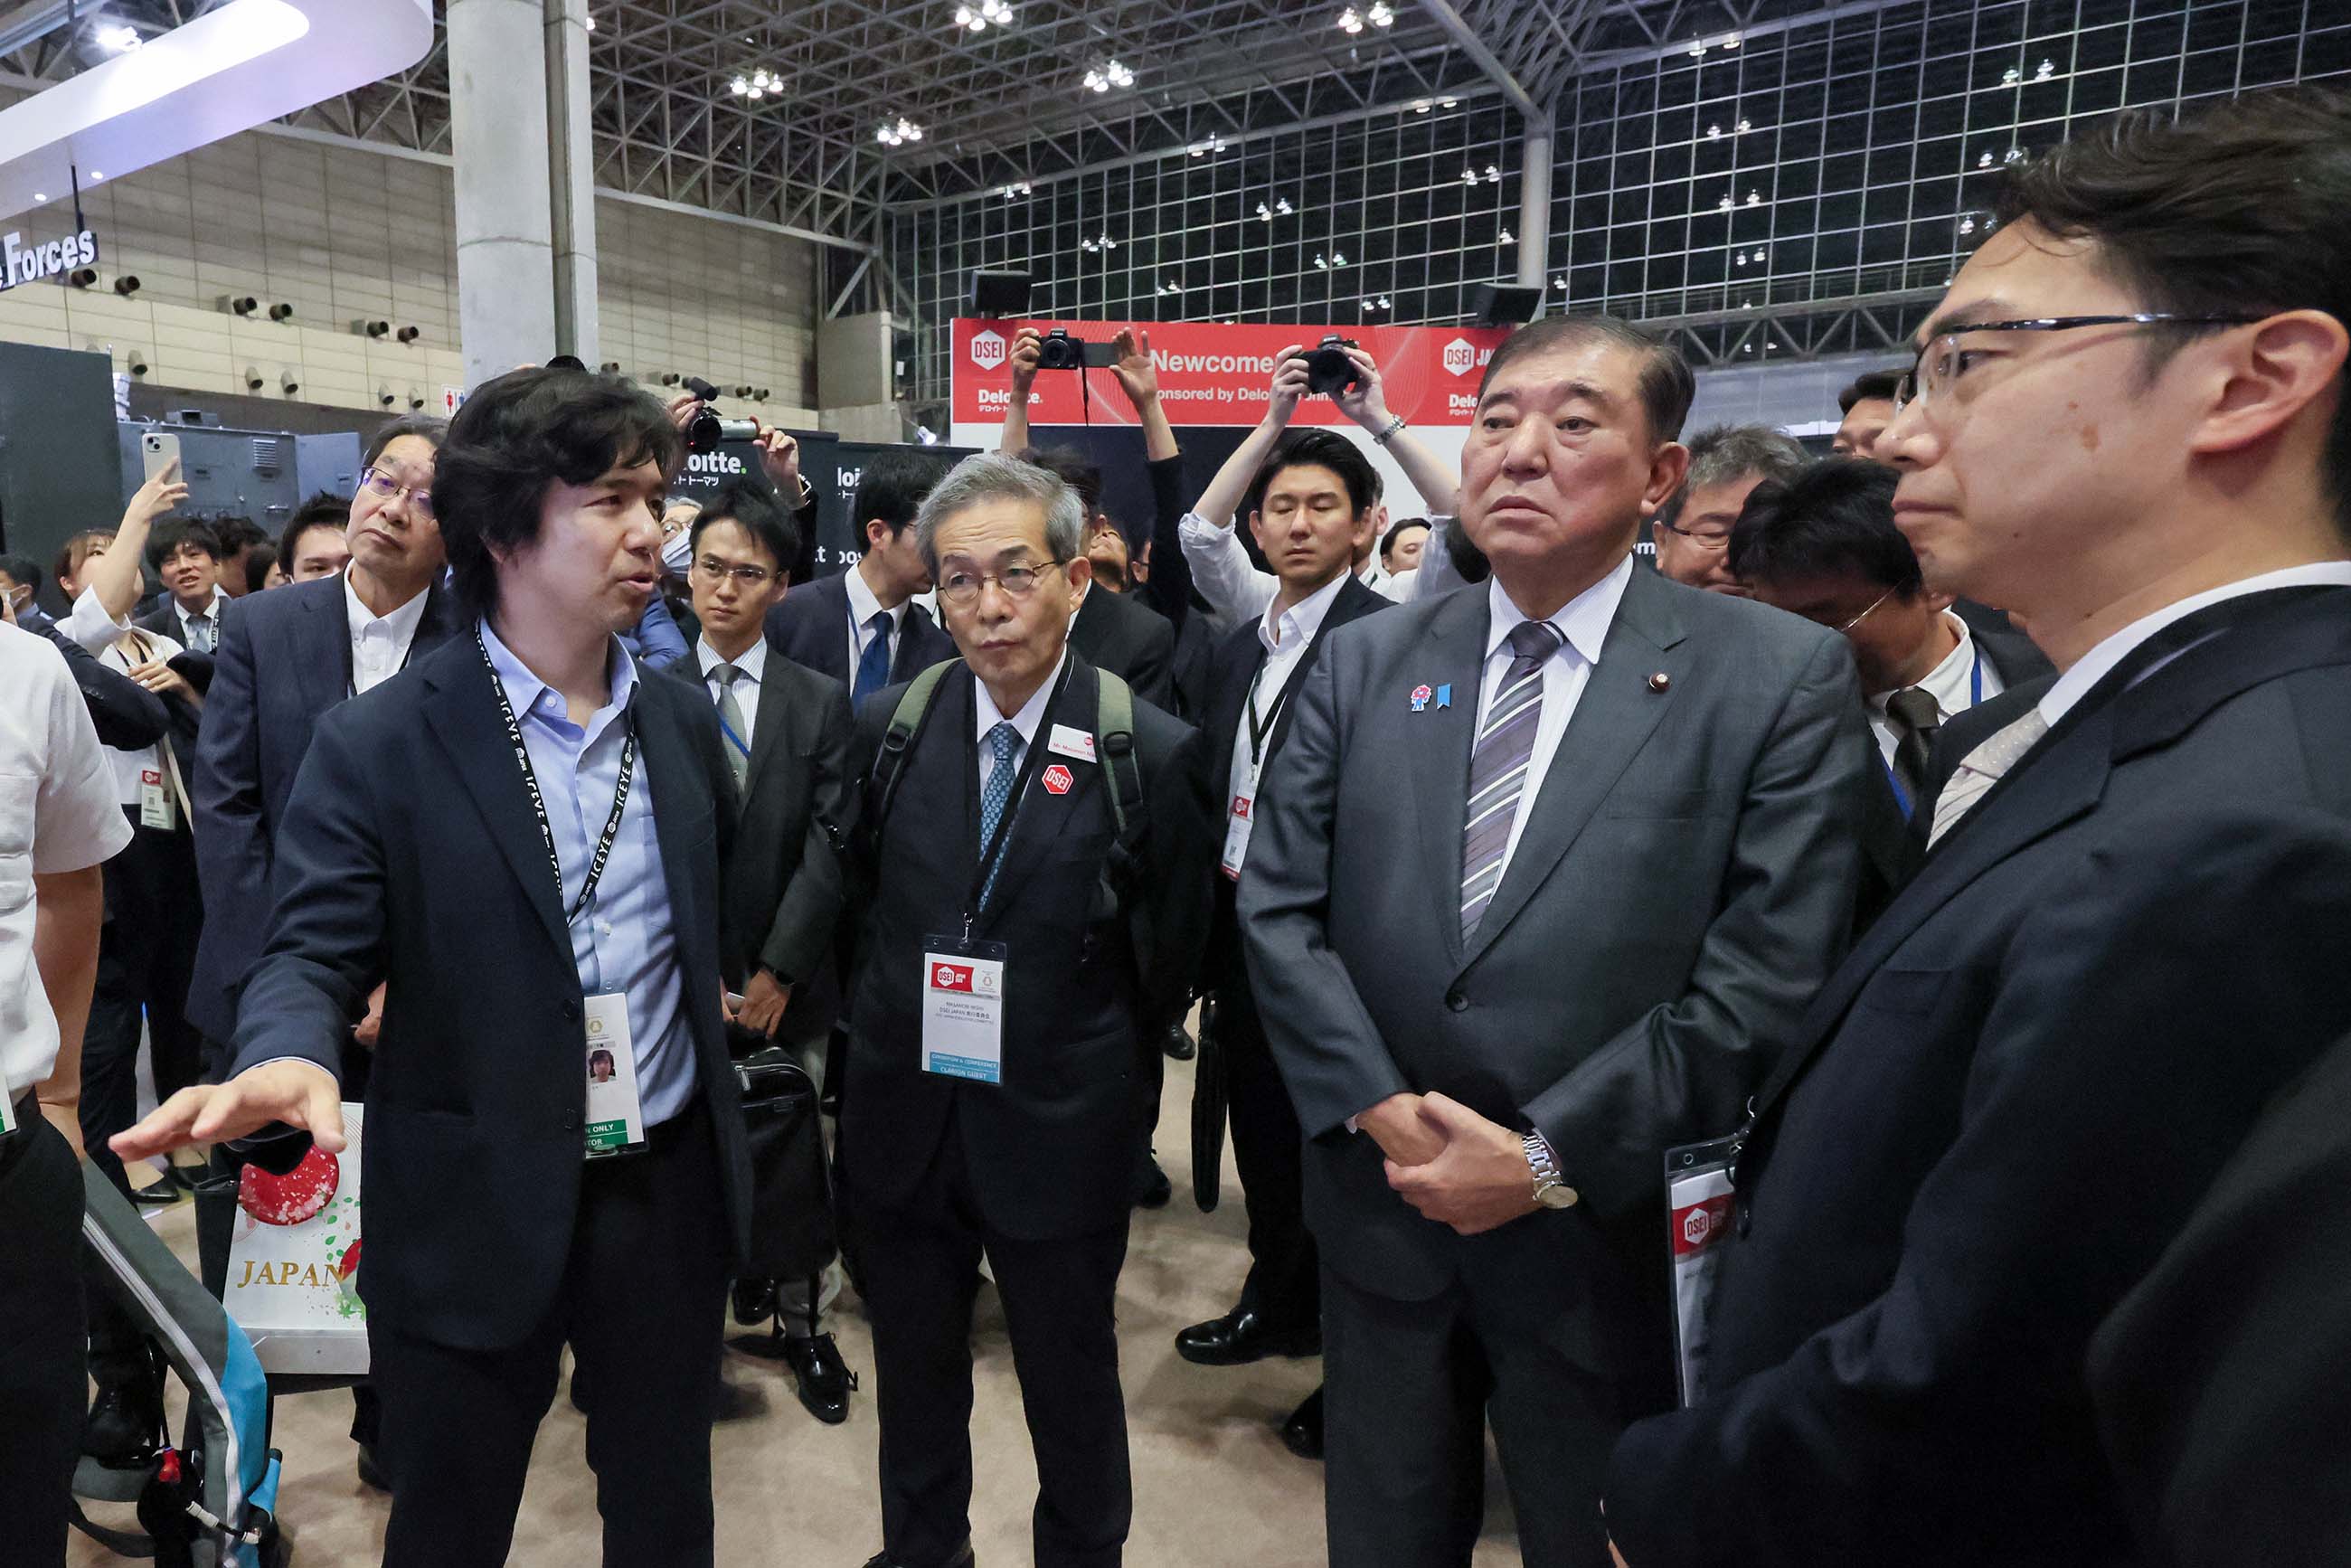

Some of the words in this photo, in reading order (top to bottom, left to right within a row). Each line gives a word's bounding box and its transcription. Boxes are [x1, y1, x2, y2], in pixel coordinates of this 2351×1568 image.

[4, 230, 95, 287] Forces
[975, 341, 1003, 358] DSEI
[1447, 349, 1472, 365] DSEI
[1150, 349, 1274, 373] Newcome
[1157, 387, 1214, 401] onsored
[1218, 387, 1234, 402] by
[1238, 388, 1270, 401] Delo
[1449, 393, 1478, 408] Delo
[687, 451, 747, 474] oitte.
[616, 766, 631, 808] ICEYE
[1045, 769, 1070, 791] DSEI
[590, 837, 612, 879] ICEYE
[939, 971, 953, 982] DSEI
[592, 1124, 614, 1133] ONLY
[1687, 1215, 1708, 1237] DSEI
[237, 1261, 347, 1289] JAPAN
